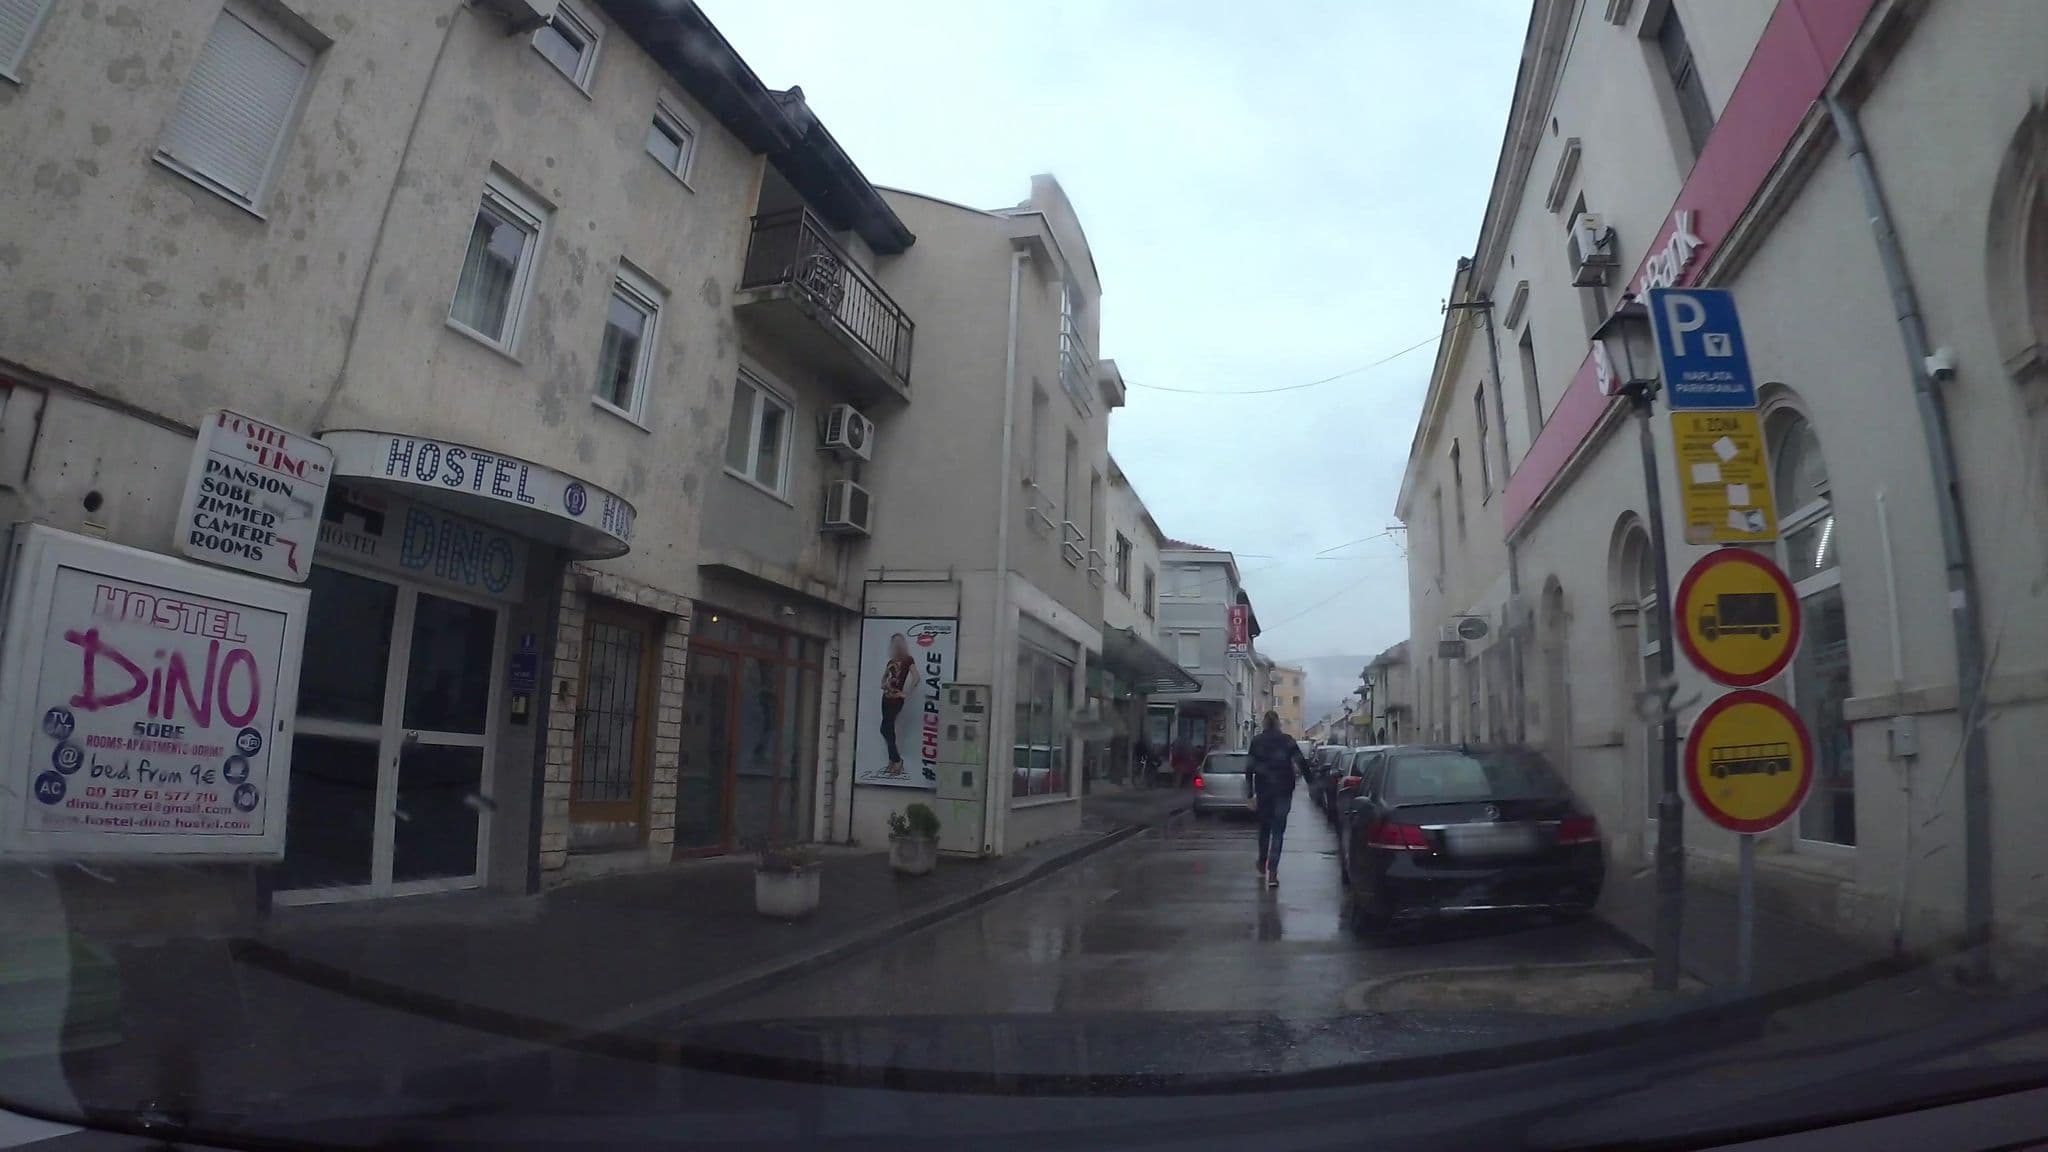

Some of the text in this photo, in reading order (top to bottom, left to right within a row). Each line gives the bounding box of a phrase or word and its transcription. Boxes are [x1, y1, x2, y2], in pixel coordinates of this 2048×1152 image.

[1663, 294, 1706, 357] P
[217, 413, 289, 450] HOSTEL
[206, 458, 294, 498] PANSION
[386, 437, 536, 505] HOSTEL
[197, 494, 276, 529] ZIMMER
[190, 530, 264, 562] ROOMS
[194, 513, 278, 547] CAMERE
[320, 523, 379, 556] HOSTEL
[400, 508, 516, 595] DINO
[93, 584, 248, 644] HOSTEL
[50, 711, 70, 723] TV
[133, 720, 186, 740] SOBE
[91, 753, 130, 779] bed
[136, 759, 182, 784] from
[40, 781, 62, 795] AC
